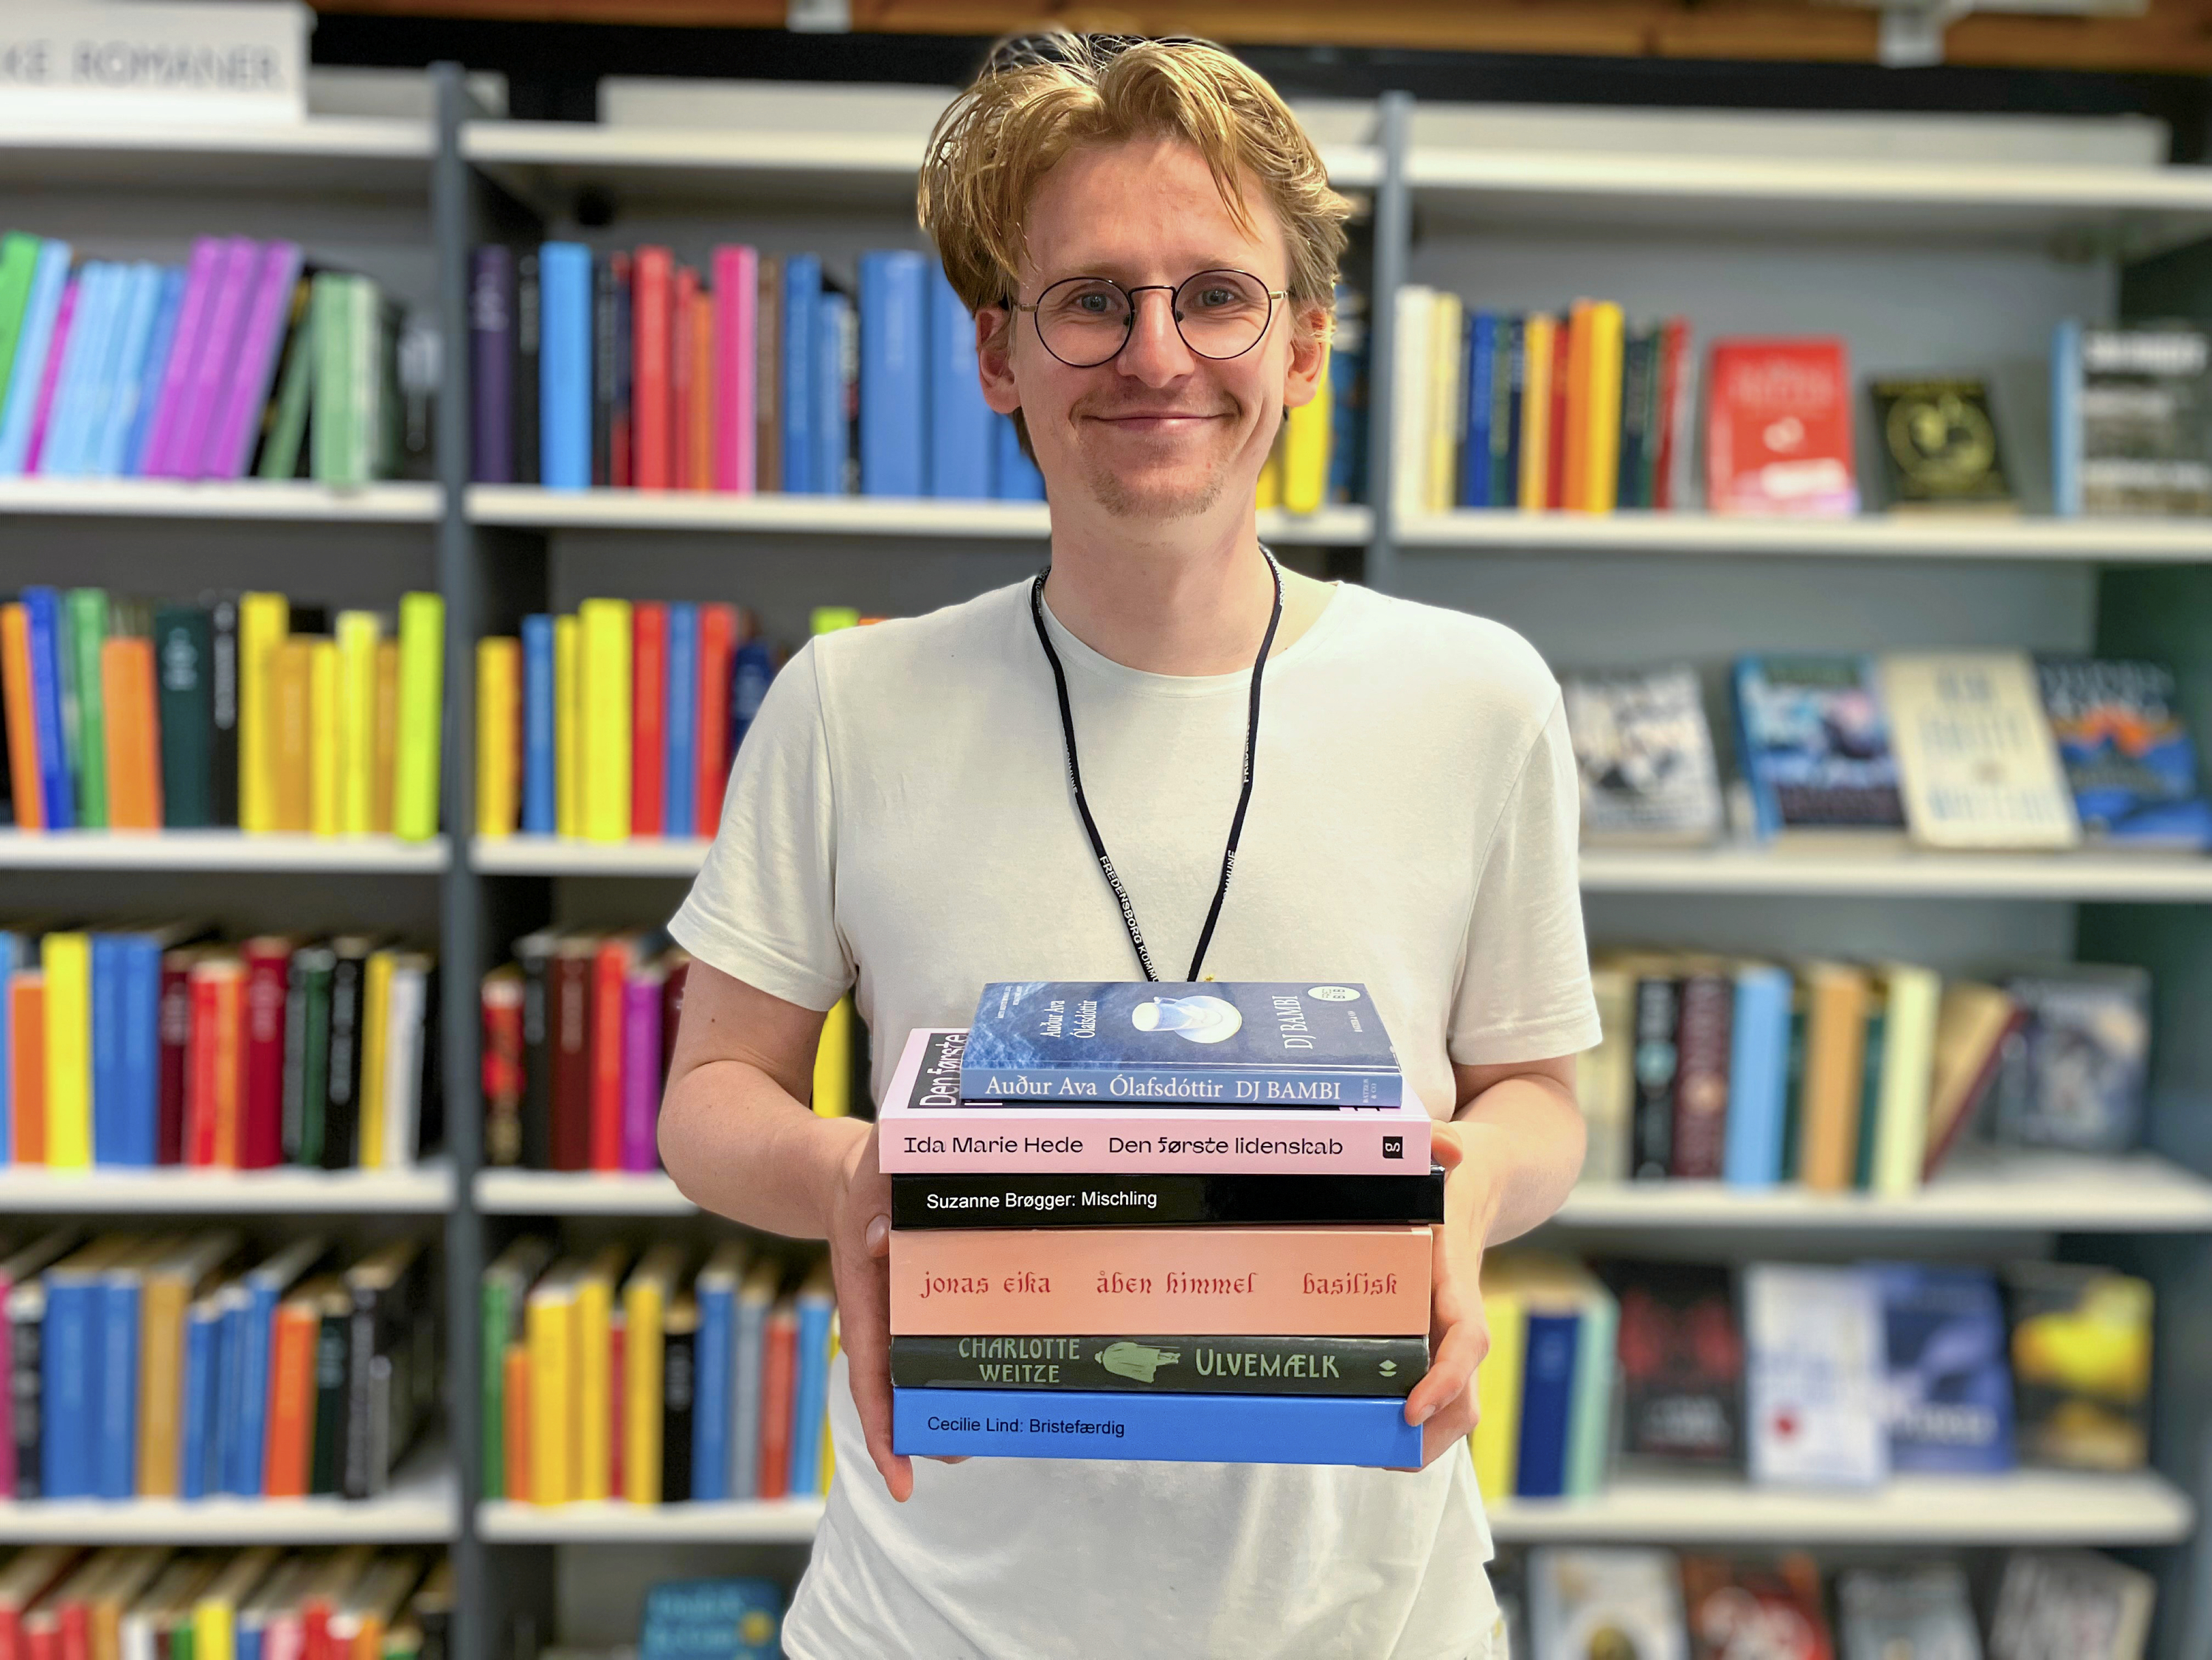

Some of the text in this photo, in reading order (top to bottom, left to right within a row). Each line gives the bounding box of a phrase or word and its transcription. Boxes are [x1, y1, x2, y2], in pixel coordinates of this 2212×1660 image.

[1099, 855, 1143, 944] FREDENSBORG
[1040, 1000, 1065, 1038] Auður Ava
[1069, 999, 1098, 1039] Ólafsdóttir
[1271, 996, 1317, 1049] DJ BAMBI
[919, 1077, 961, 1106] Den
[985, 1073, 1341, 1102] Auður Ava Ólafsdóttir DJ BAMBI
[904, 1136, 1343, 1155] Ida Marie Hede Den første lidenskab
[926, 1190, 1158, 1211] Suzanne Brøgger: Mischling
[919, 1270, 1397, 1299] jonas eika åben himmel basilisk
[959, 1338, 1080, 1360] CHARLOTTE
[1195, 1348, 1340, 1378] ULVEMÆLK
[978, 1364, 1060, 1383] WEITZE
[928, 1416, 1125, 1439] Cecilie Lind: Bristefærdig
